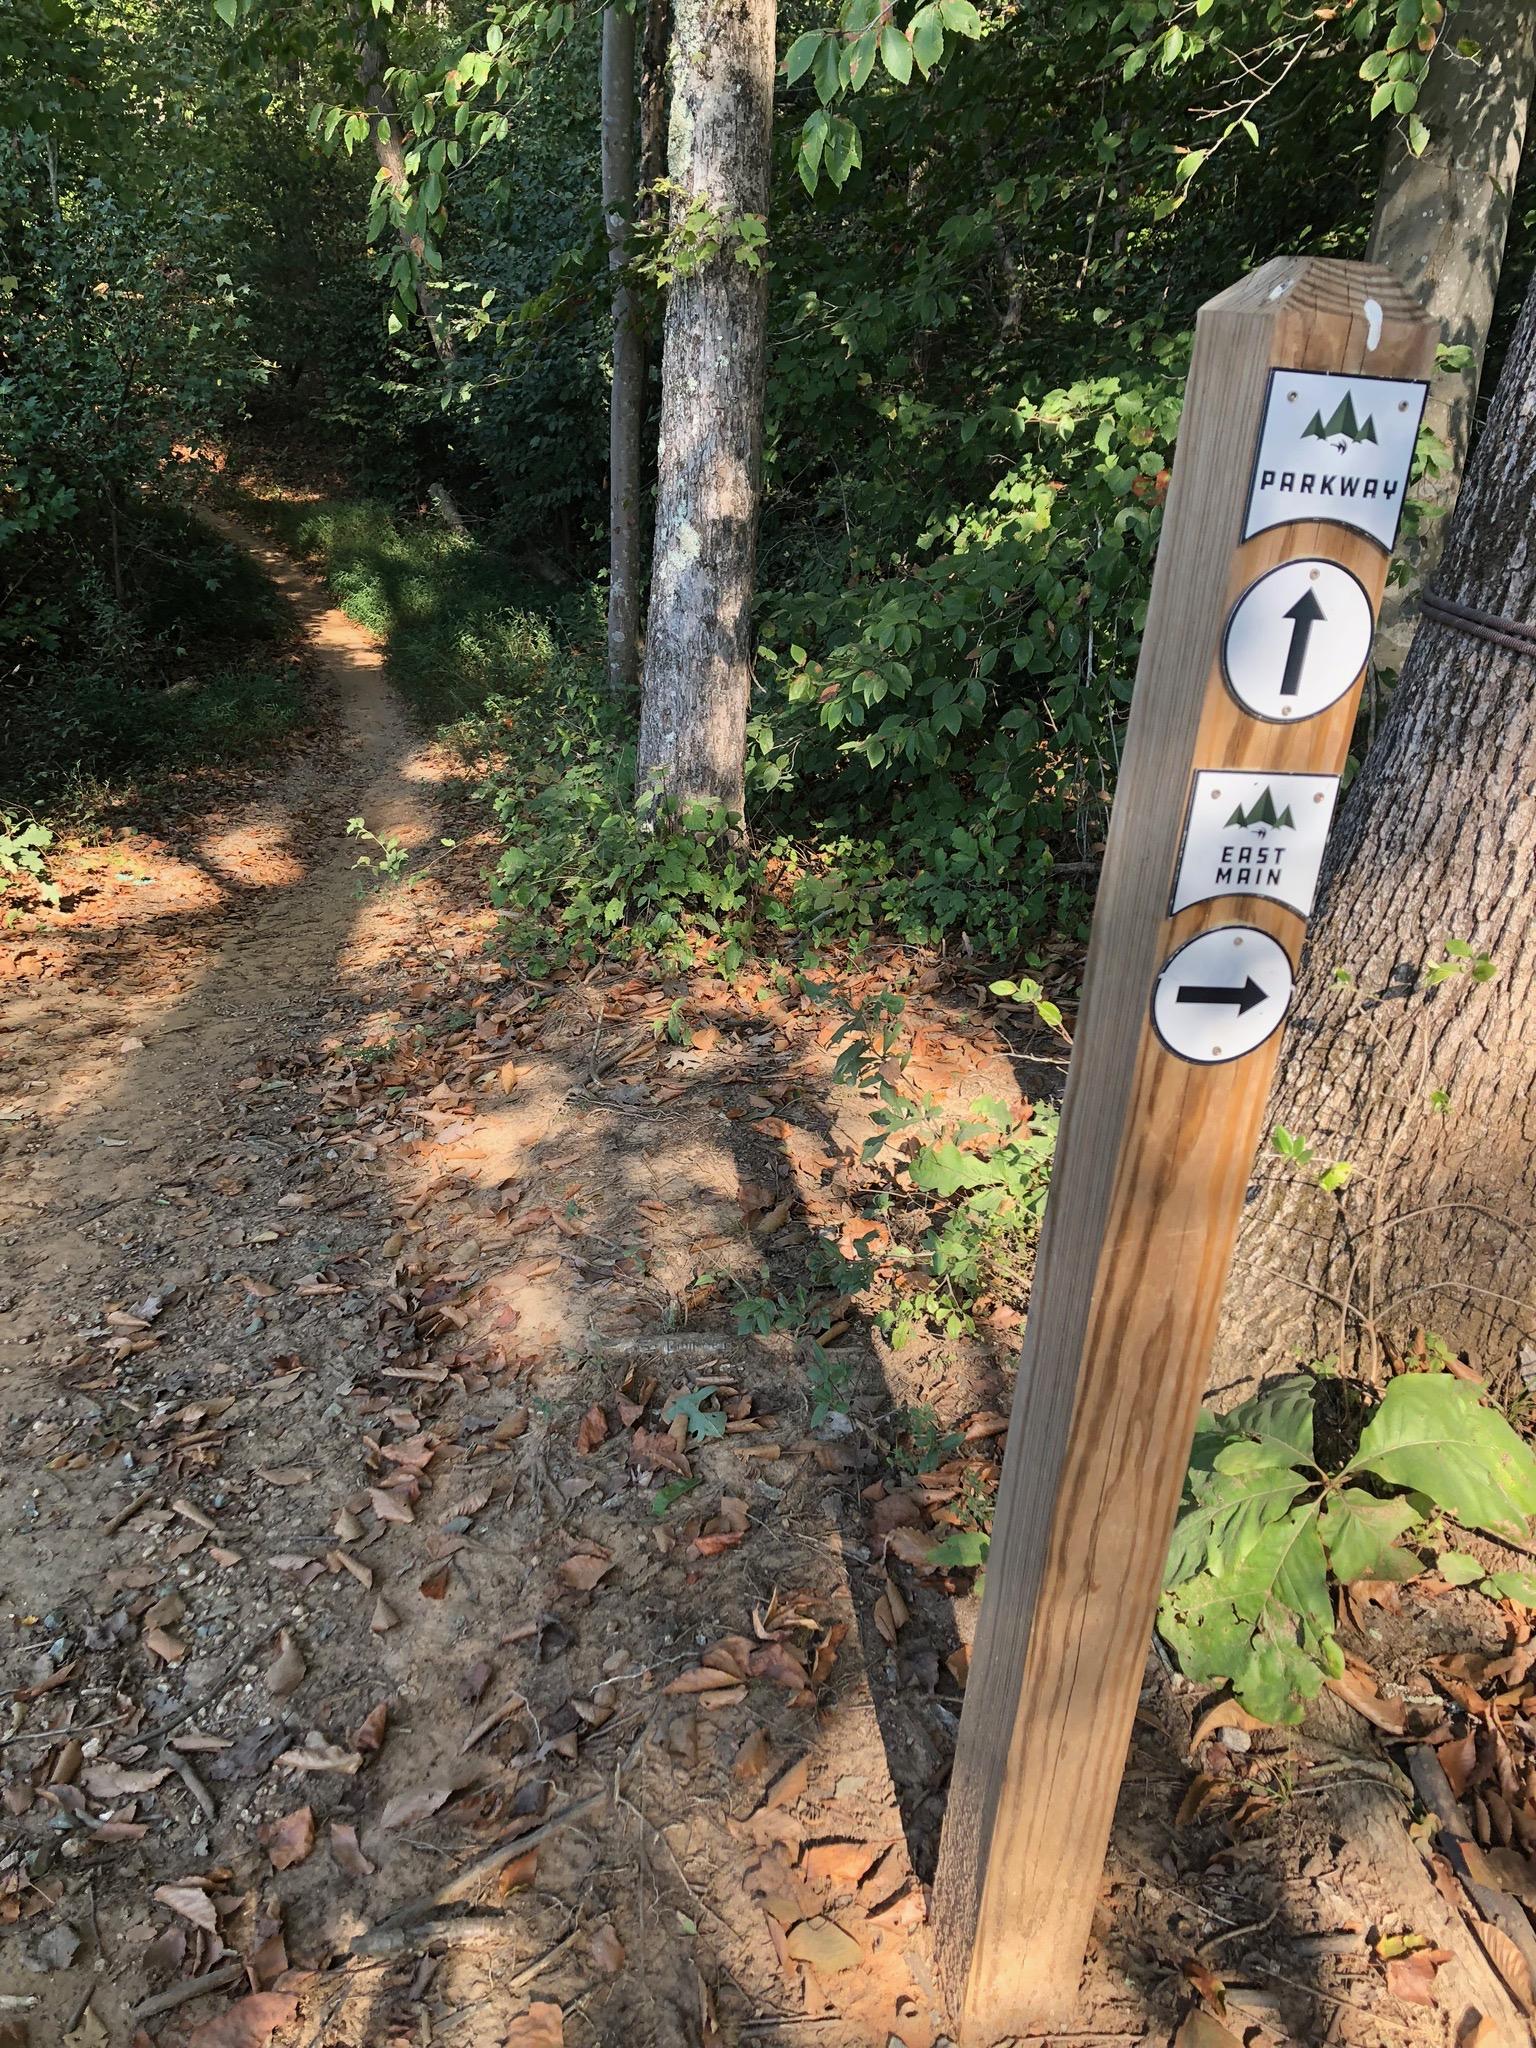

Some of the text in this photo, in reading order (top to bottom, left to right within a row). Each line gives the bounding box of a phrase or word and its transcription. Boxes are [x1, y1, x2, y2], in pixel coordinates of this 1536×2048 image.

[1260, 470, 1398, 500] PARKWAY
[1221, 846, 1286, 864] EAST
[1215, 867, 1282, 885] MAIN
